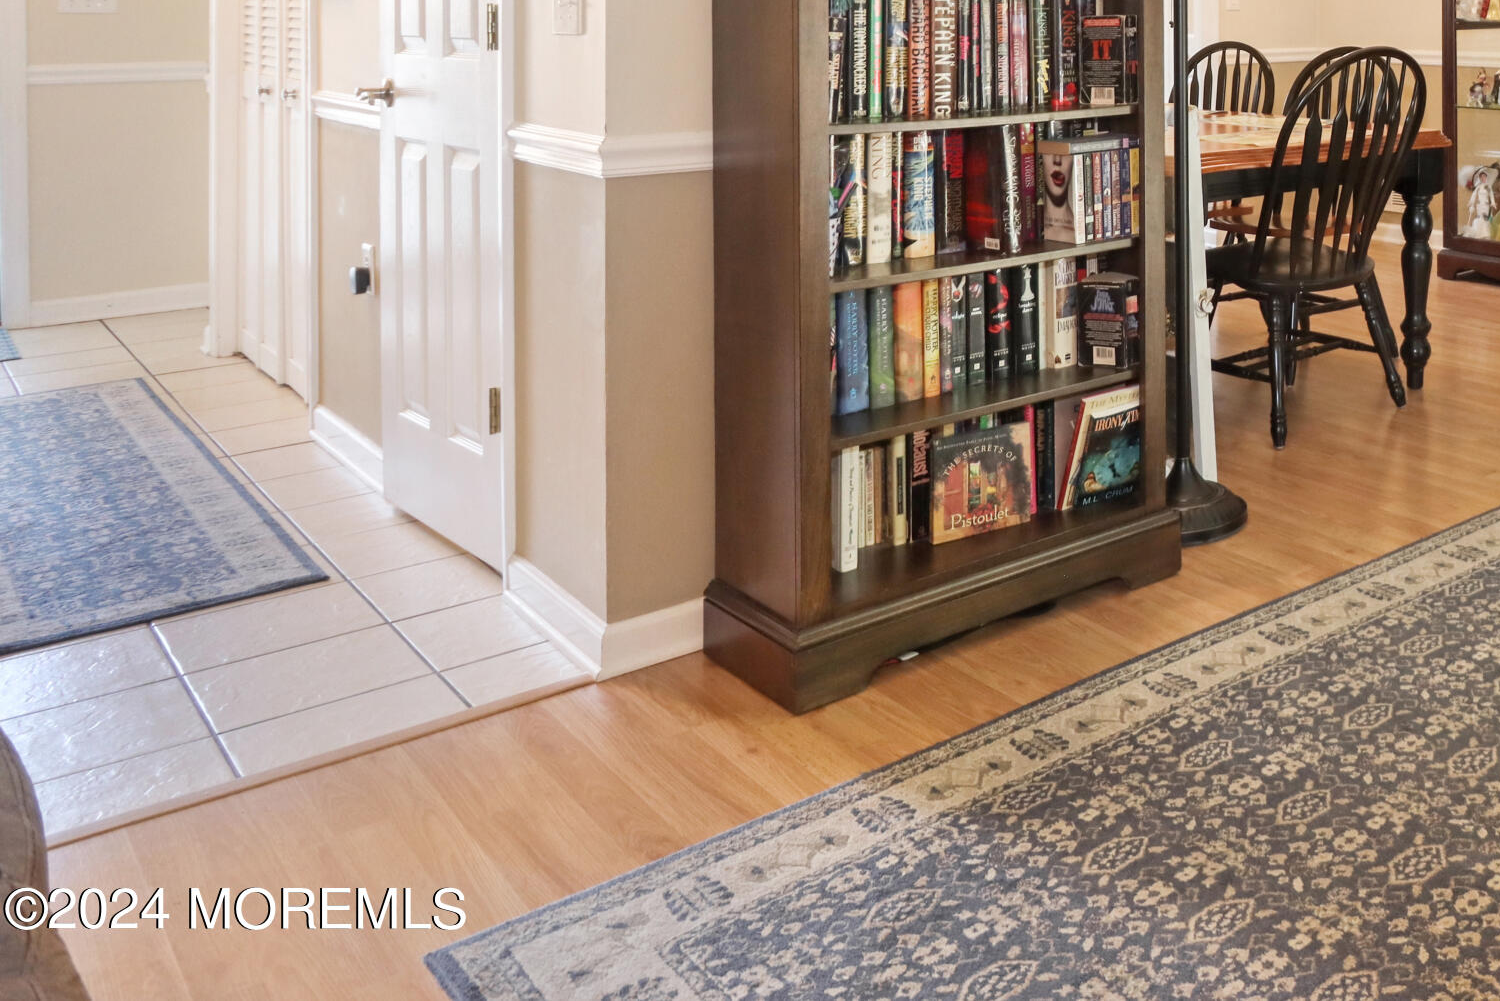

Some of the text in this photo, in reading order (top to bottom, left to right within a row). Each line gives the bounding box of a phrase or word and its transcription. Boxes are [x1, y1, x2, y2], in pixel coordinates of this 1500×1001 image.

[854, 8, 867, 25] THE
[1038, 12, 1047, 37] KING
[1061, 10, 1076, 47] KING
[853, 26, 867, 95] TOMMYKNOCKERS
[1092, 39, 1112, 60] IT
[911, 48, 925, 118] BACHMAN
[934, 73, 951, 119] KING
[871, 136, 882, 180] KING
[913, 177, 924, 201] KING
[924, 176, 934, 221] STEPHEN
[1005, 175, 1019, 202] KING
[880, 297, 888, 332] HARRY
[930, 287, 938, 318] HARRY
[850, 302, 858, 375] HARRY POTTER
[1095, 415, 1123, 431] IRONY
[943, 444, 1017, 477] THE SECRETS OF
[951, 504, 1009, 530] Pistoulet
